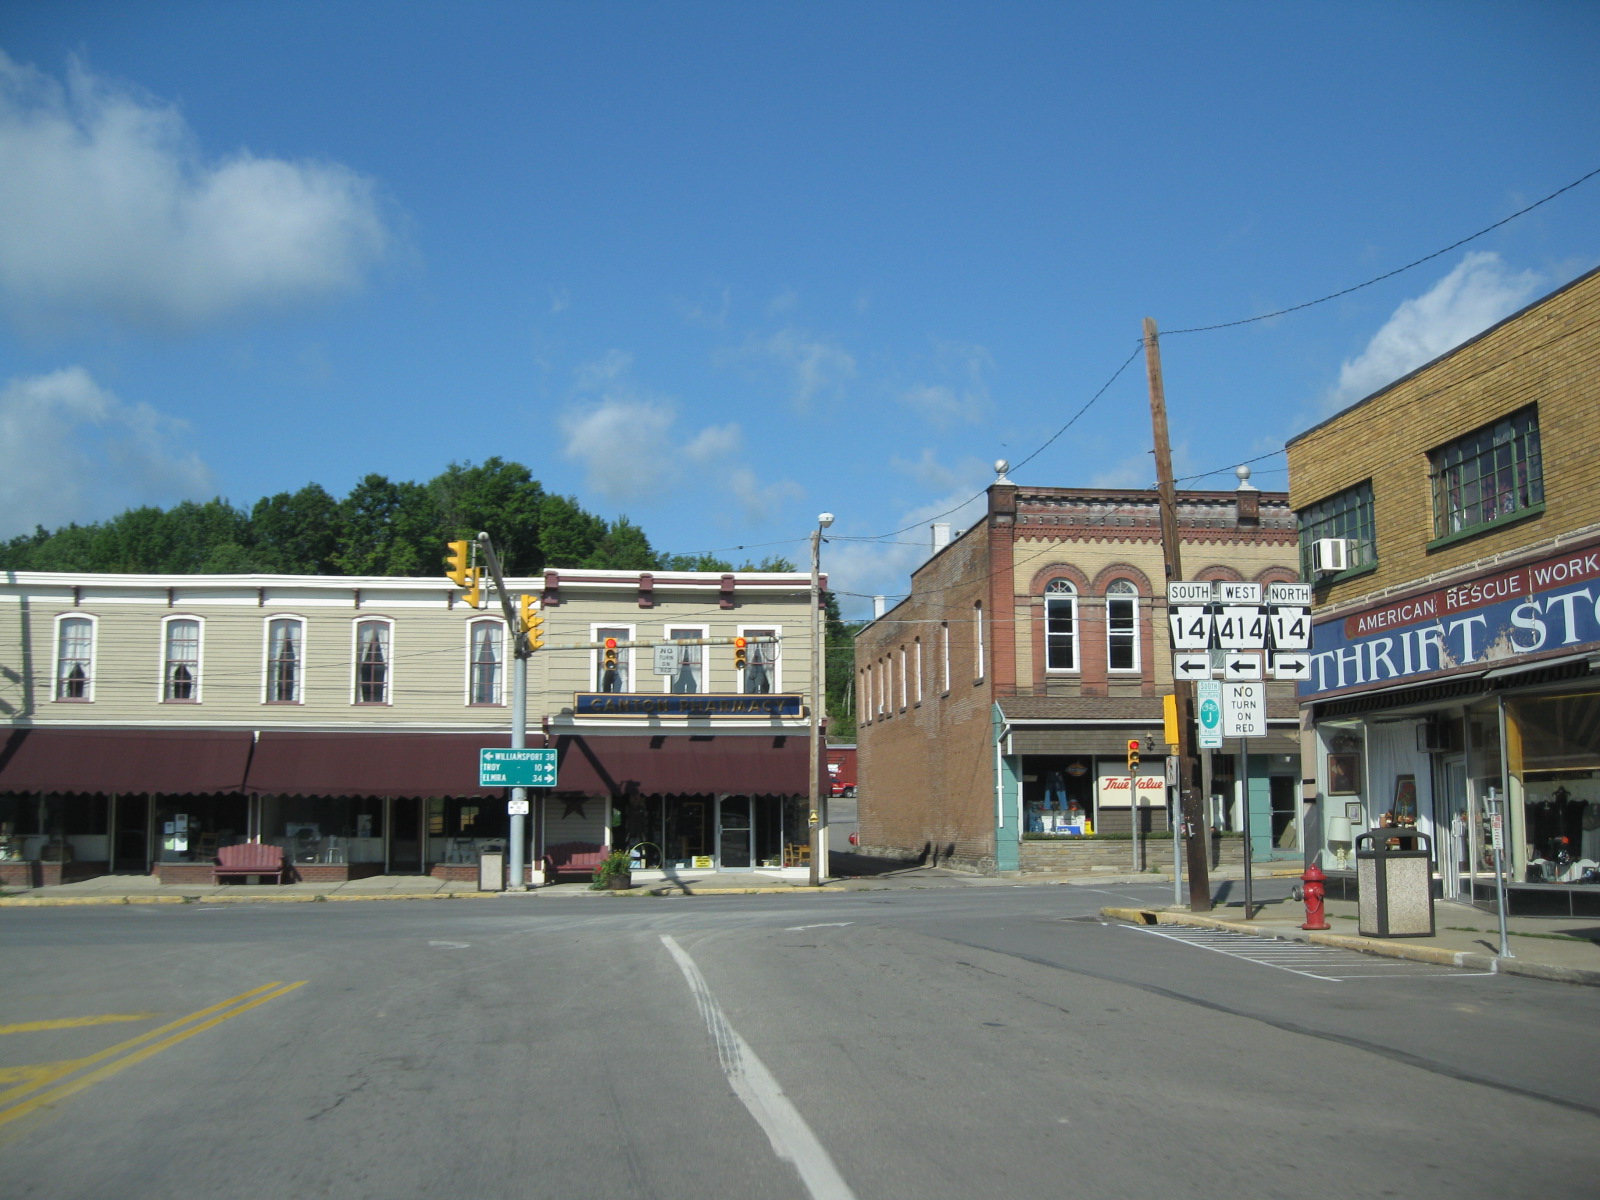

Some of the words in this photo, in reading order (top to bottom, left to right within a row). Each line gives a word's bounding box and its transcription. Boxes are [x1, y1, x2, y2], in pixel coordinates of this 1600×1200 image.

[1171, 586, 1209, 599] SOUTH
[1225, 586, 1256, 599] WEST
[1271, 588, 1309, 601] NORTH
[1357, 598, 1435, 633] AMERICAN
[1446, 575, 1521, 610] RESCUE
[1534, 553, 1600, 586] WORK
[1176, 617, 1205, 640] 14
[1220, 616, 1263, 640] 414
[1277, 617, 1305, 640] 14
[1311, 613, 1488, 692] THRIFT
[1510, 587, 1600, 653] ST
[1200, 682, 1218, 690] SOUTH
[1233, 687, 1253, 698] NO
[590, 699, 668, 712] CANTON
[679, 699, 785, 712] PHARMACY
[1232, 701, 1257, 709] TURN
[1206, 712, 1212, 723] J
[1237, 712, 1251, 721] ON
[1236, 724, 1254, 733] RED
[495, 752, 543, 761] WILLIAMSPORT
[545, 753, 555, 761] 38
[483, 763, 501, 771] TROY
[534, 763, 542, 772] 10
[482, 773, 507, 782] ELMIRA
[532, 774, 542, 782] 34
[1103, 778, 1130, 790] True
